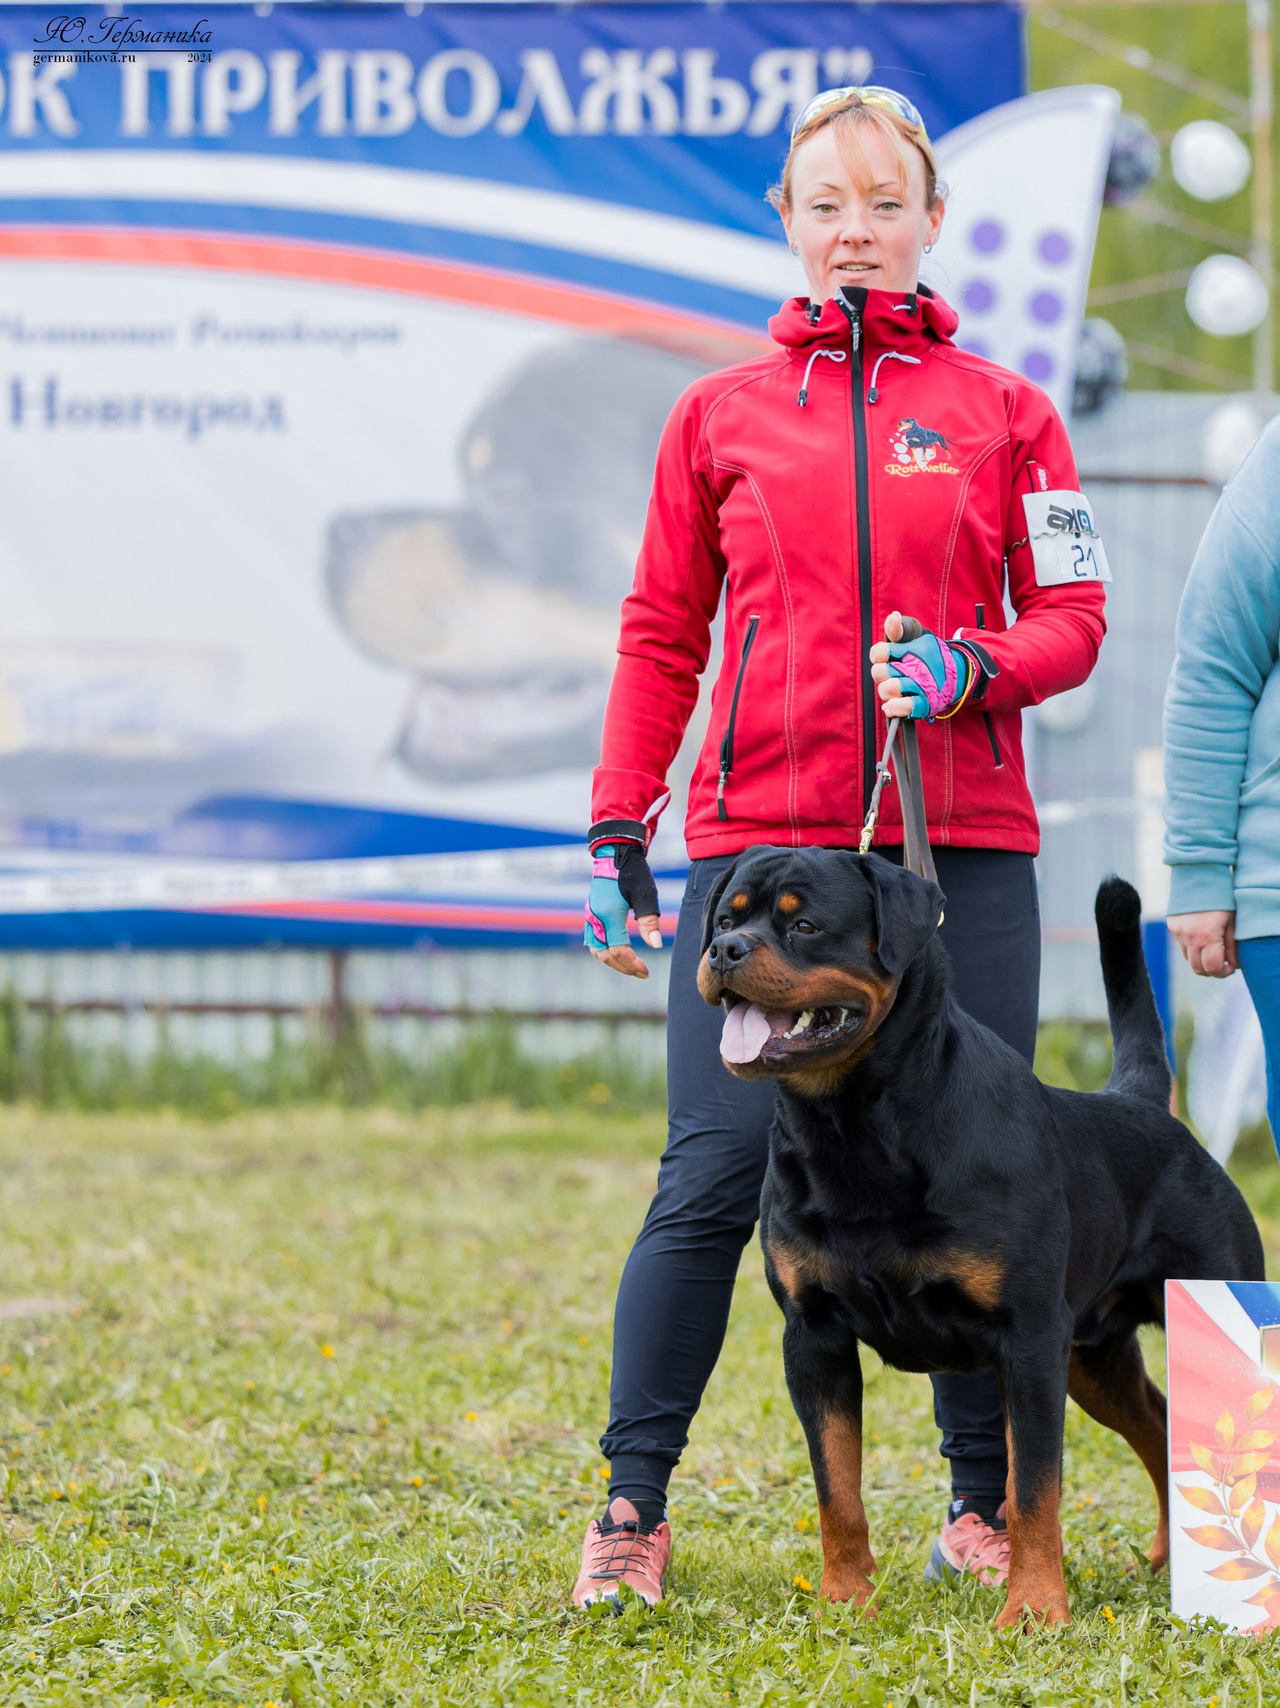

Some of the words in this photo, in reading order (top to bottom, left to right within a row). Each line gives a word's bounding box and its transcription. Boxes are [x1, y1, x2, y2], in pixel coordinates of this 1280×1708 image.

[0, 51, 80, 138] К
[884, 462, 960, 477] Rottweiler
[1071, 545, 1098, 577] 21
